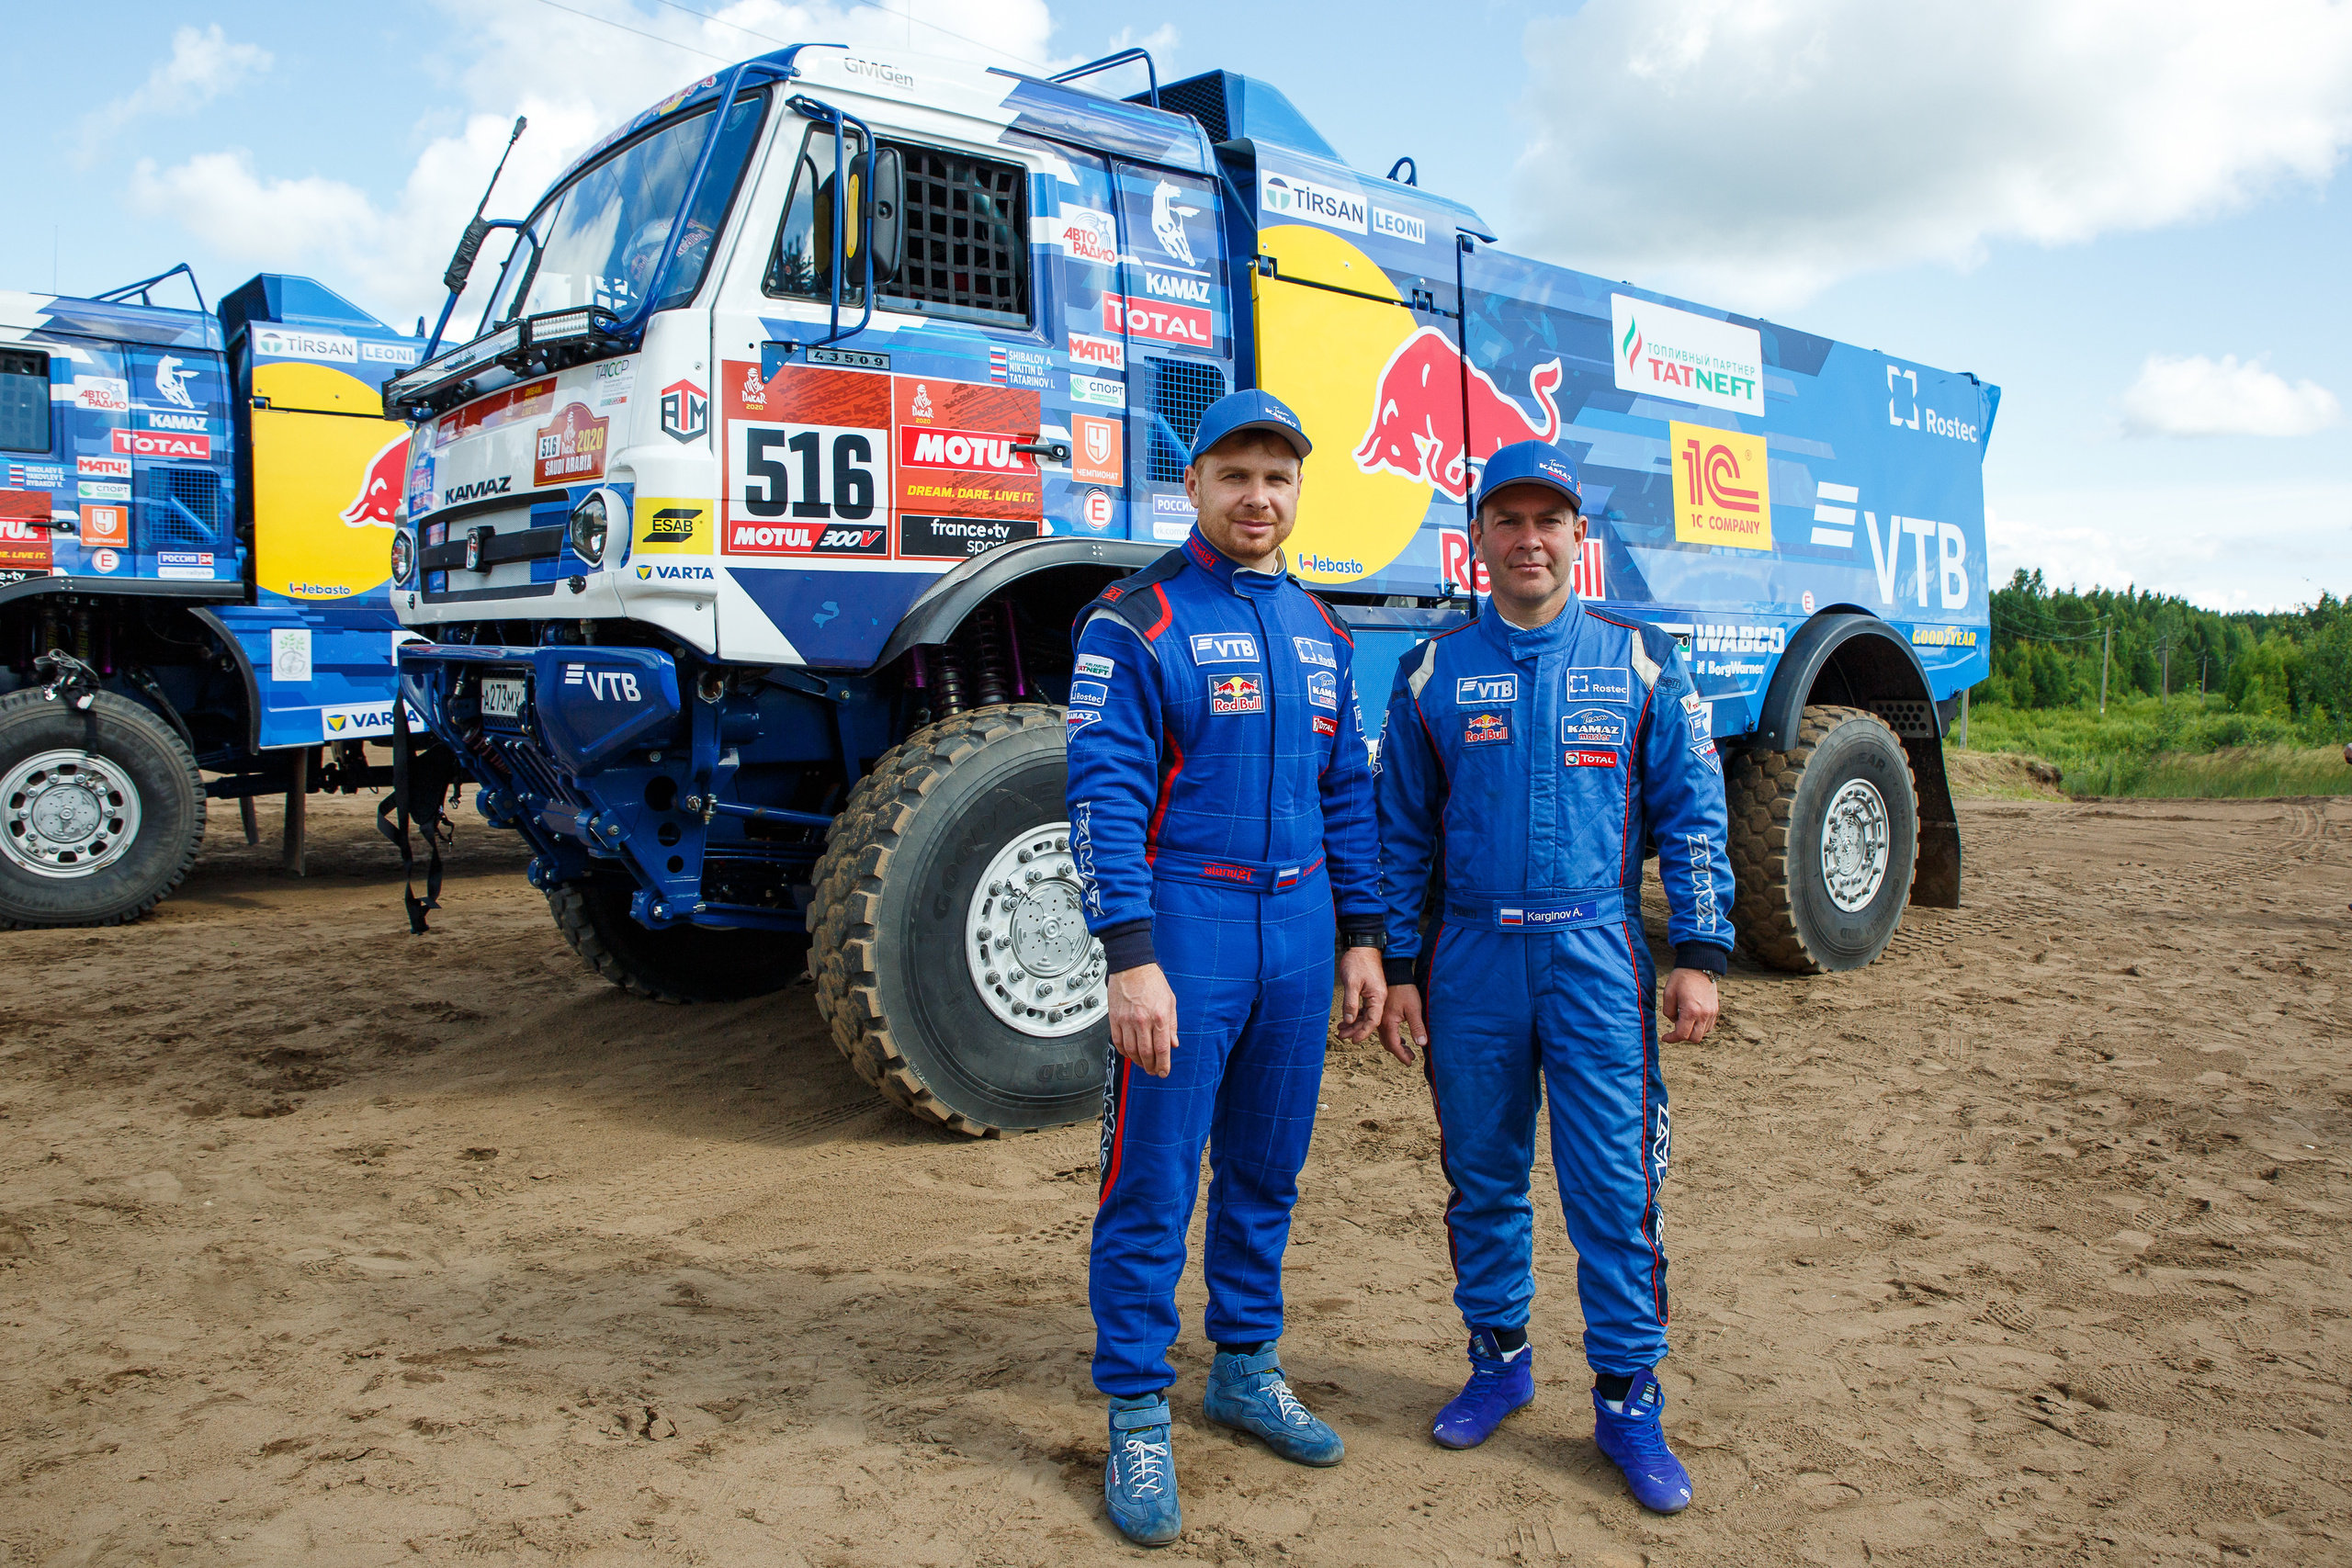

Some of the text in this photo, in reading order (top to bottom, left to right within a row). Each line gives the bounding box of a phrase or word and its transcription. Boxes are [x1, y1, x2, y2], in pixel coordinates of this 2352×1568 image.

[1375, 212, 1423, 239] LEONI
[1063, 227, 1097, 244] АВТО
[1073, 242, 1114, 263] РАДИО
[1146, 272, 1210, 304] KAMAZ
[1108, 299, 1206, 341] TOTAL
[366, 347, 413, 361] LEONI
[1009, 351, 1053, 366] SHIBALOV A.
[1069, 338, 1121, 366] МАТЧ!
[1647, 343, 1755, 376] ТОПЛИВНЫЙ ПАРТНЕР
[1009, 363, 1045, 376] NIKITIN D.
[1009, 374, 1056, 389] TATARINOV I.
[1648, 357, 1755, 400] TATNEFT
[79, 389, 109, 400] АВТО
[741, 390, 767, 404] DAKAR
[1090, 382, 1124, 396] СПОРТ
[912, 405, 934, 418] DAKAR
[150, 413, 208, 431] KAMAZ
[1926, 408, 1977, 443] Rostec
[117, 433, 207, 456] TOTAL
[542, 436, 557, 457] 516
[577, 426, 605, 453] 2020
[913, 434, 1023, 468] MOTUL
[78, 459, 128, 475] МАТЧ!
[545, 455, 593, 477] SAUDI ARABIA
[746, 428, 874, 520] 516
[1077, 468, 1119, 481] ЧЕМПИОНАТ
[1539, 462, 1572, 482] KAMAZ
[445, 475, 512, 505] KAMAZ
[907, 485, 1035, 502] DREAM. DARE. LIVE IT.
[1091, 499, 1105, 521] E
[0, 521, 38, 539] TUL
[652, 519, 694, 533] ESAB
[1709, 515, 1760, 535] COMPANY
[733, 526, 883, 547] MOTUL 300V
[967, 539, 1007, 555] spor
[101, 554, 112, 567] E
[163, 555, 212, 563] РОССИЯ 24
[1299, 553, 1363, 574] Webasto
[1440, 530, 1491, 596] Re
[1863, 511, 1969, 610] VTB
[656, 566, 715, 580] VARTA
[289, 582, 351, 595] Webasto
[1696, 625, 1785, 653] WABCO
[1214, 639, 1255, 658] VTB
[1317, 653, 1337, 668] Rost
[1709, 660, 1765, 677] BorgWarner
[1076, 665, 1109, 676] ATNEFT
[586, 671, 642, 702] VTB
[1312, 685, 1337, 699] KAMA
[1477, 681, 1513, 698] VTB
[1592, 683, 1627, 694] Rostec
[1077, 693, 1102, 704] Rostec
[1214, 695, 1261, 712] Red Bull
[351, 710, 420, 728] VARA
[1318, 721, 1335, 733] TOTAL
[1581, 712, 1609, 725] Team
[1464, 727, 1509, 743] Red Bull
[1567, 725, 1620, 735] KAMAZ
[1578, 733, 1611, 741] master
[1580, 753, 1614, 764] TOTAL
[1687, 834, 1716, 934] KAMAZ
[1573, 908, 1583, 918] A.
